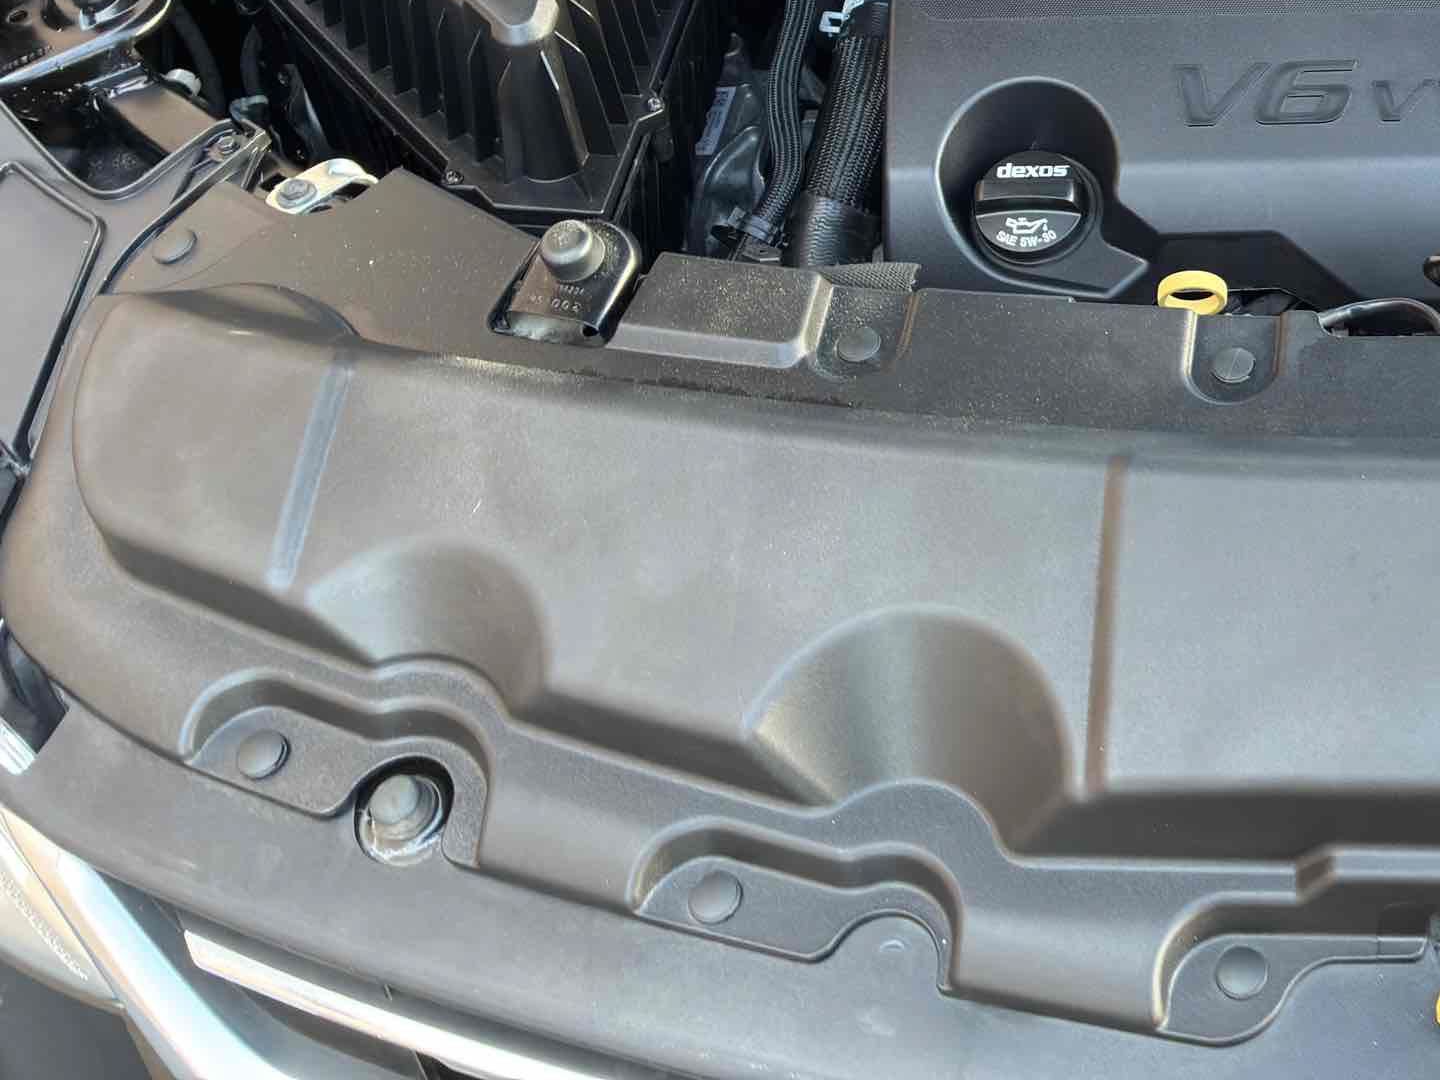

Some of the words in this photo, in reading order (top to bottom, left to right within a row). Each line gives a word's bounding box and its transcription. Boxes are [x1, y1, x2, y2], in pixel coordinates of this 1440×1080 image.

[1174, 59, 1358, 126] V6
[996, 163, 1070, 178] dexos
[995, 230, 1018, 247] SAE
[1019, 230, 1057, 248] 5W-30
